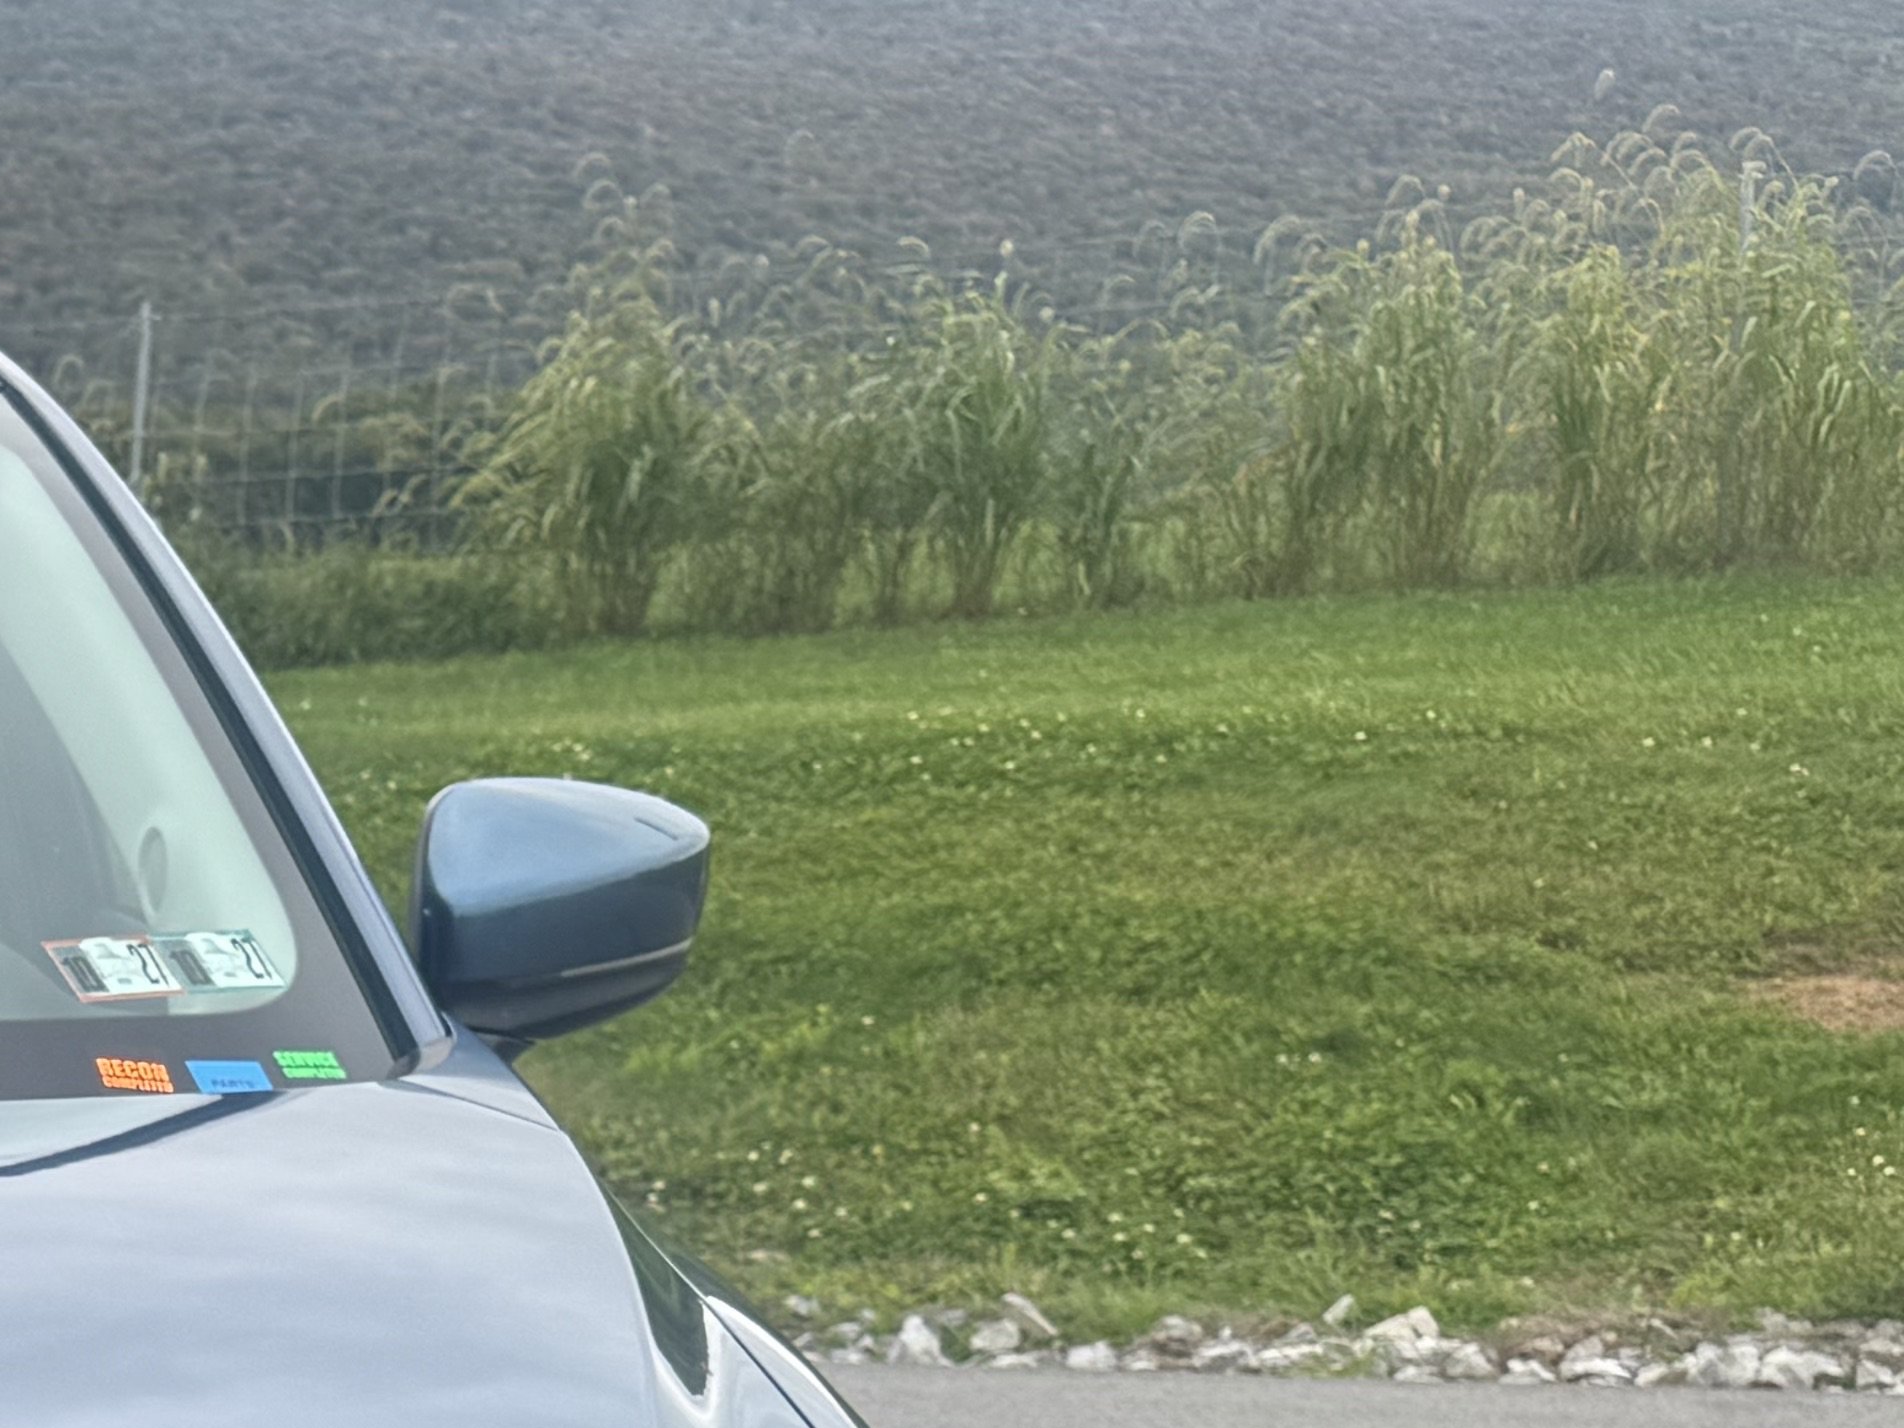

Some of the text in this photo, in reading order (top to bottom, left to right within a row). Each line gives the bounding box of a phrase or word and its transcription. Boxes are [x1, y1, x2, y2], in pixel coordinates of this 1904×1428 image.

[127, 943, 169, 987] 27
[230, 938, 272, 979] 27
[96, 1058, 169, 1081] RECON
[210, 1078, 255, 1089] PARTS
